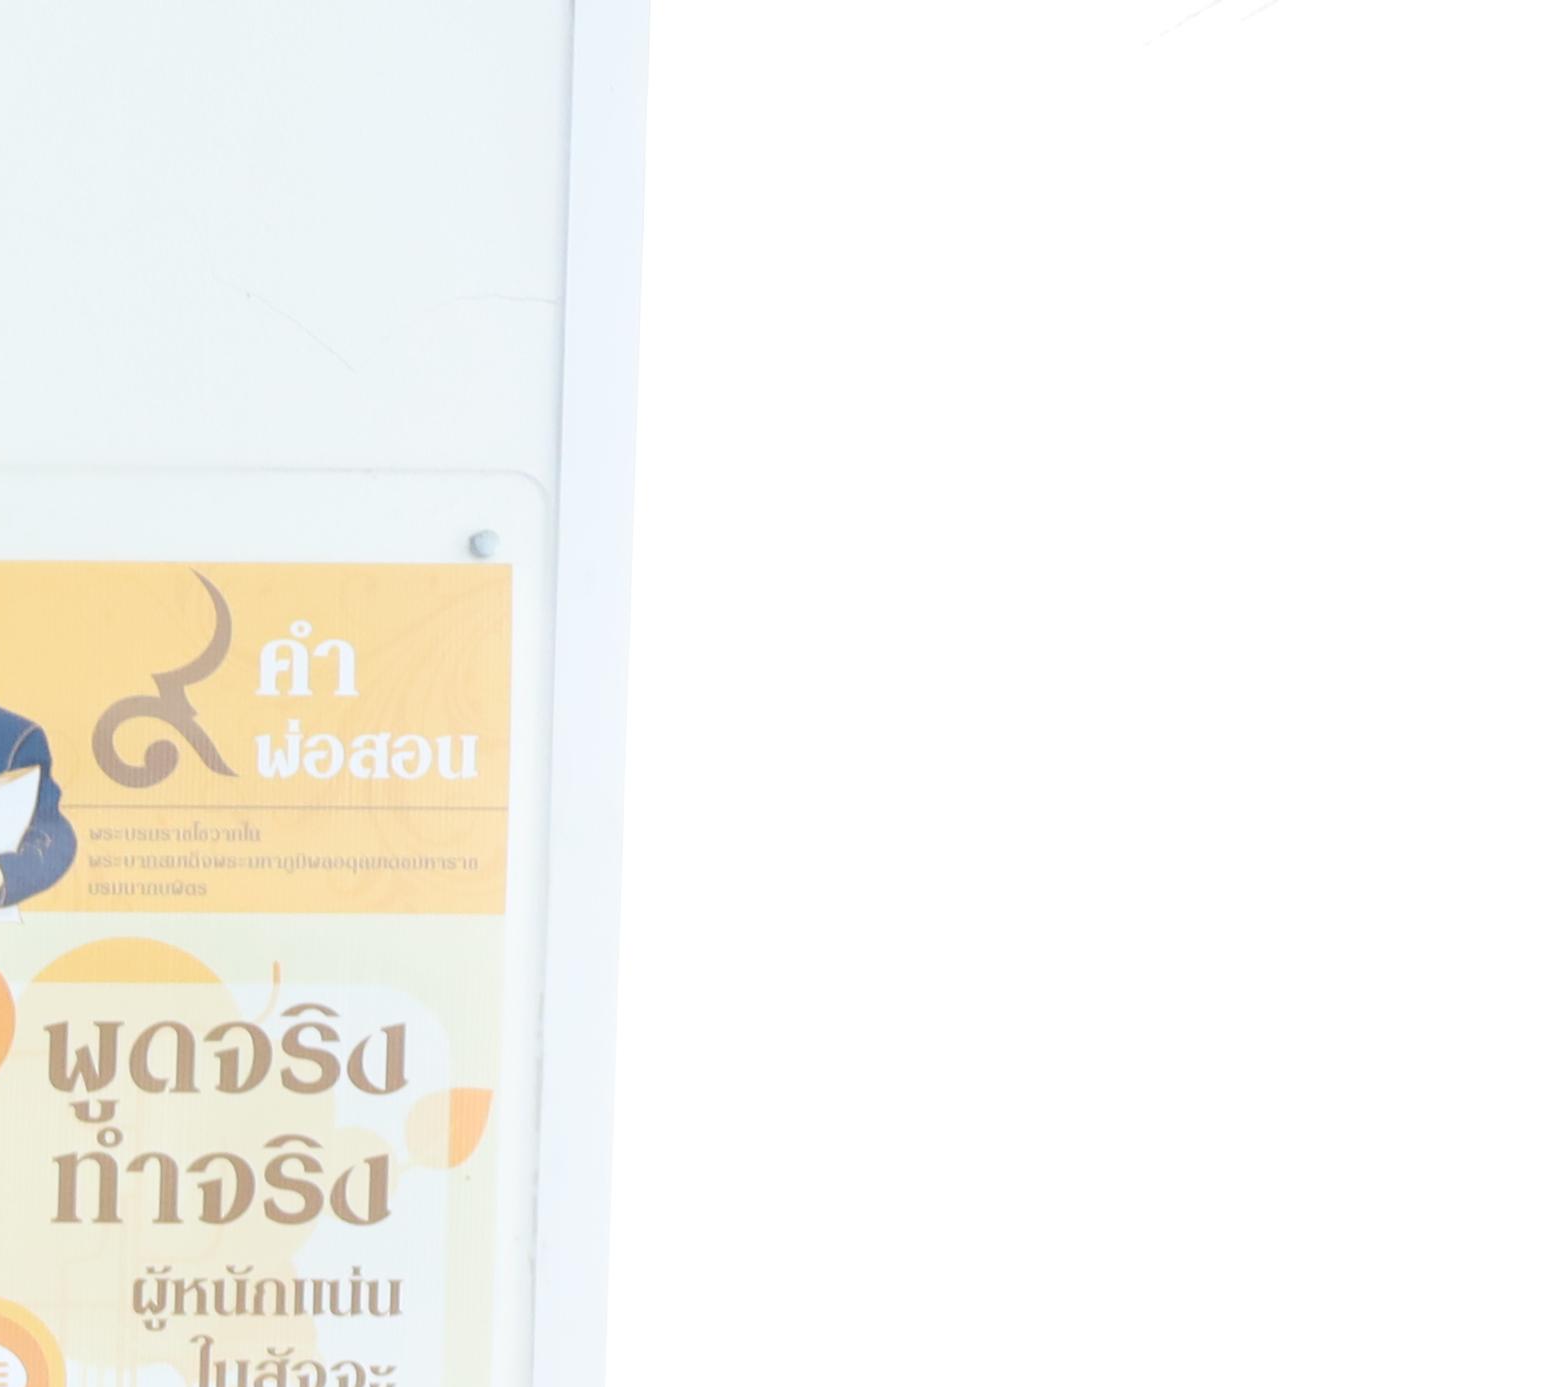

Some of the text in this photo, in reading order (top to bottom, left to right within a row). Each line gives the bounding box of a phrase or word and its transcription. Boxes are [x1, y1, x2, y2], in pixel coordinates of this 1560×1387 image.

[255, 620, 359, 697] คำ
[255, 719, 478, 780] พ่อสอน
[43, 1002, 409, 1124] พูดจริง
[49, 1126, 392, 1227] ทำจริง
[131, 1264, 403, 1332] ผู้หนักแน่น
